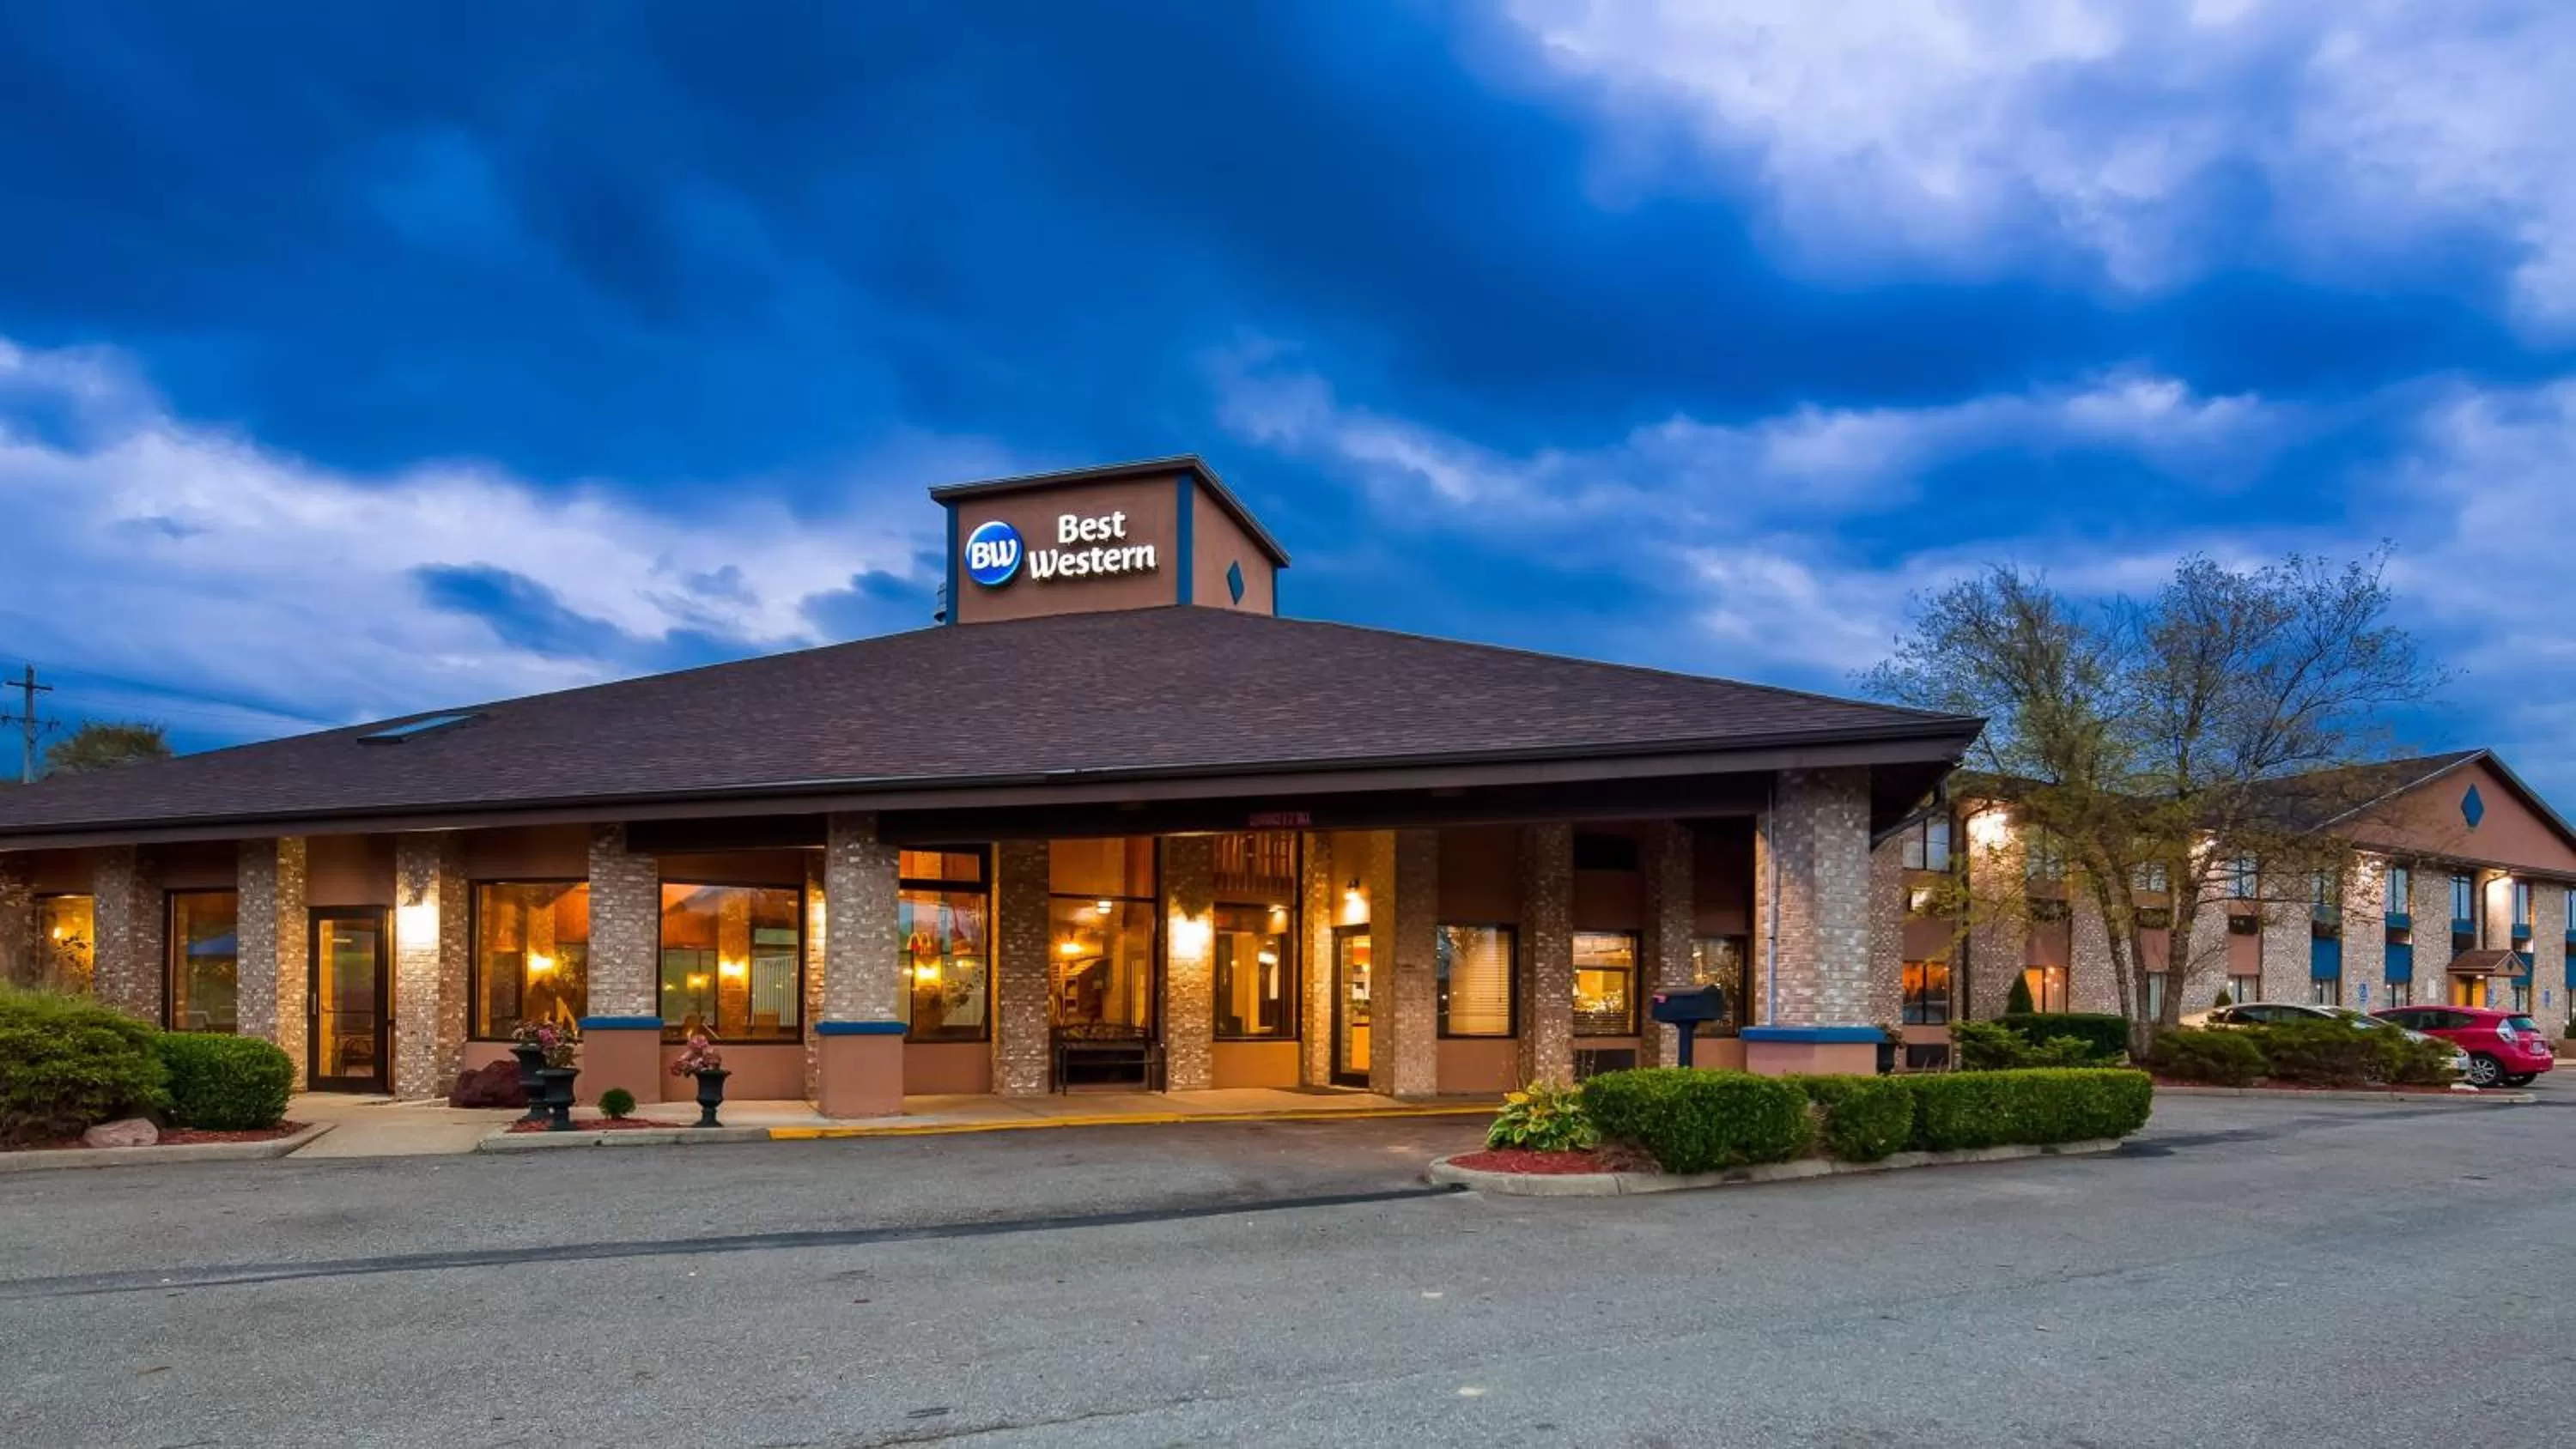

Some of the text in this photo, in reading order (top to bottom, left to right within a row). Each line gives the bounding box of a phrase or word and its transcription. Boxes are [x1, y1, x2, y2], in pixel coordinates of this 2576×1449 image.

[1058, 511, 1127, 543] Best
[971, 538, 1018, 570] BW
[1029, 544, 1157, 579] Western
